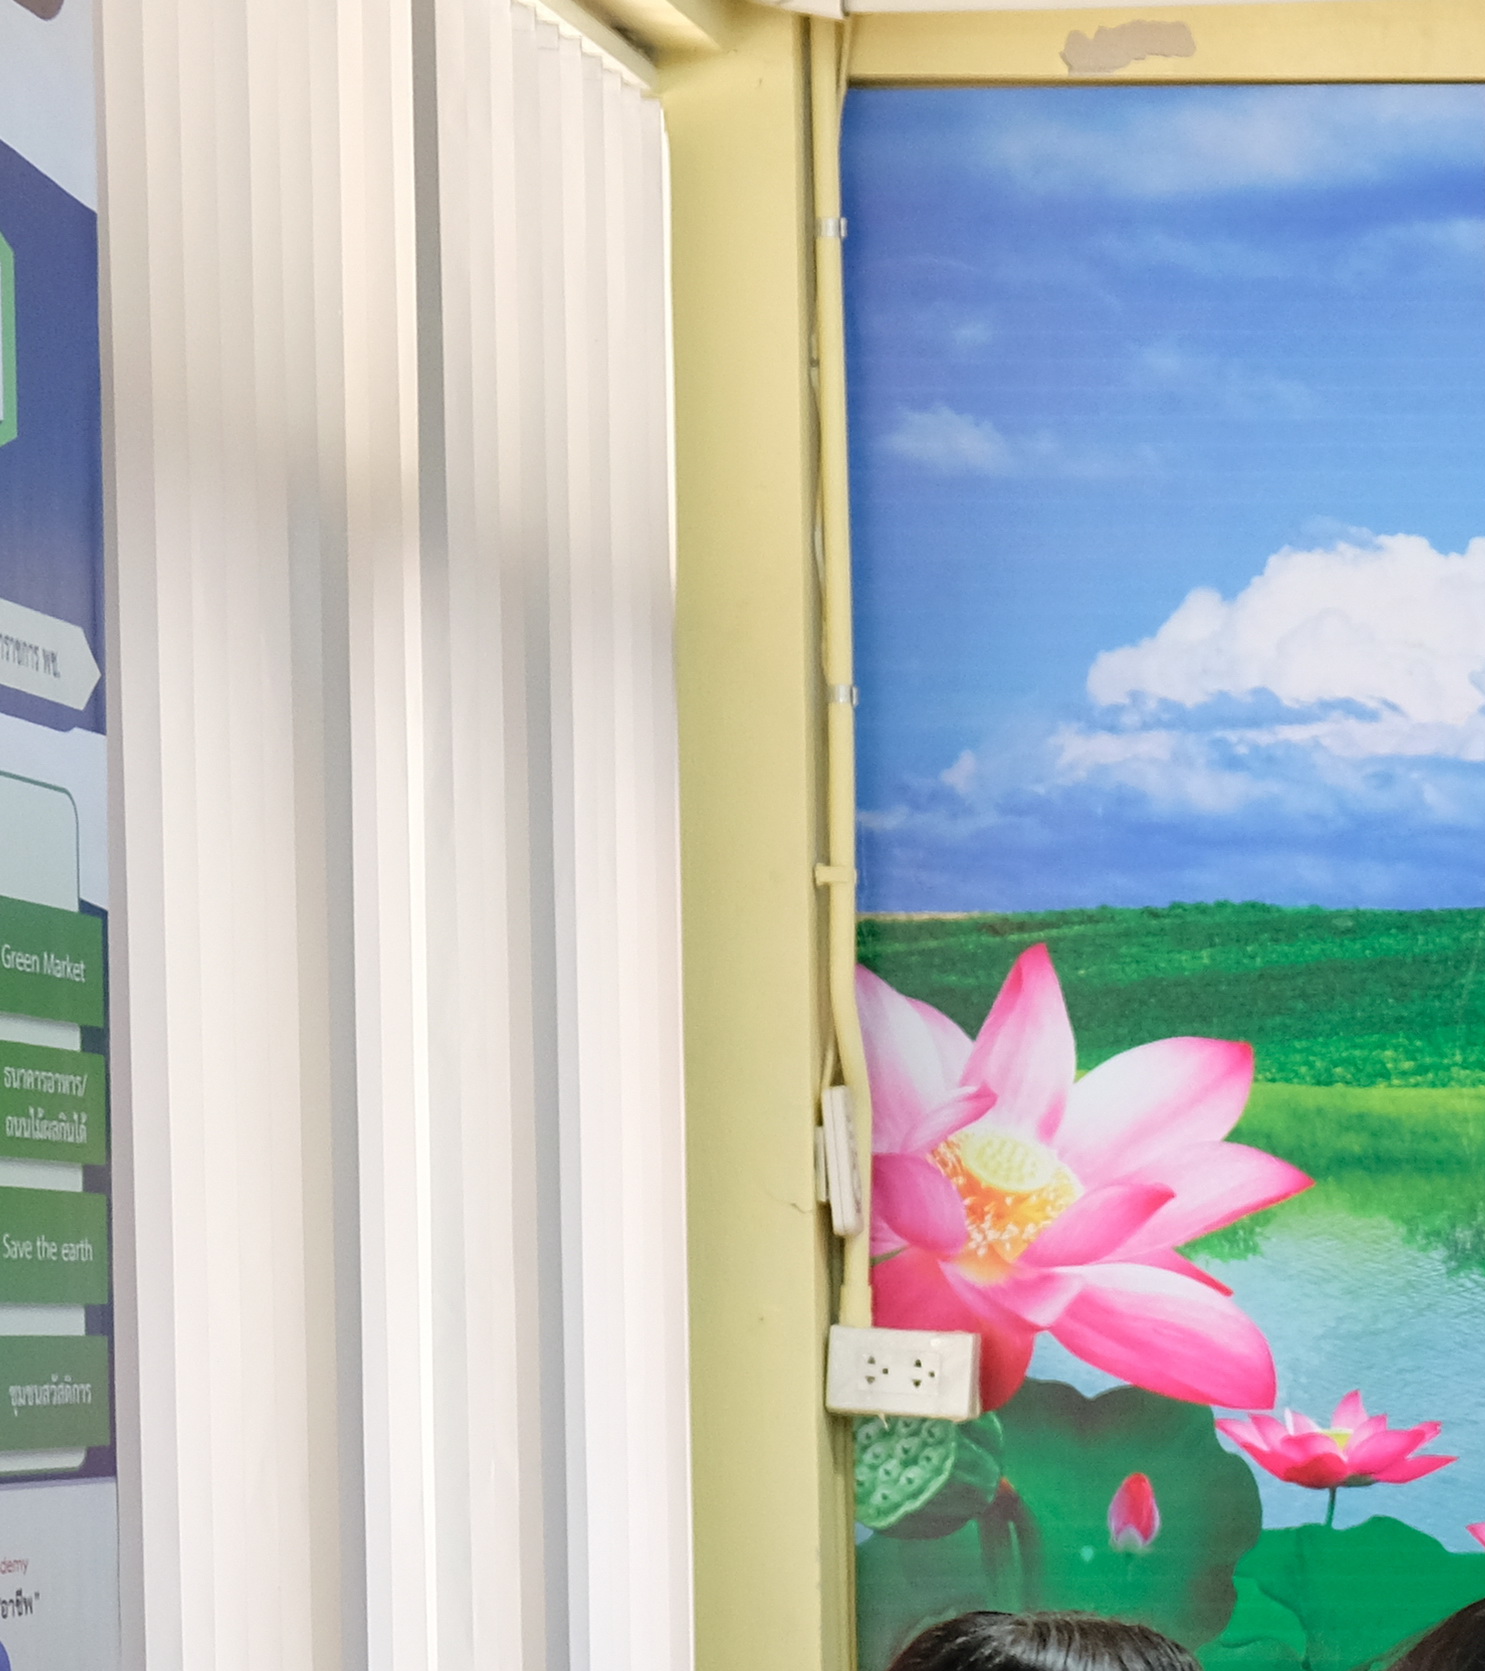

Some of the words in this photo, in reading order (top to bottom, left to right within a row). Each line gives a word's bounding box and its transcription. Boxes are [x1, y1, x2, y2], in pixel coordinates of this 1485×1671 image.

[2, 944, 39, 974] Green
[43, 951, 86, 983] Market
[2, 1233, 33, 1260] Save
[37, 1235, 58, 1261] the
[61, 1238, 93, 1262] earth
[9, 1374, 92, 1416] ชุมชนสวัสดิการ
